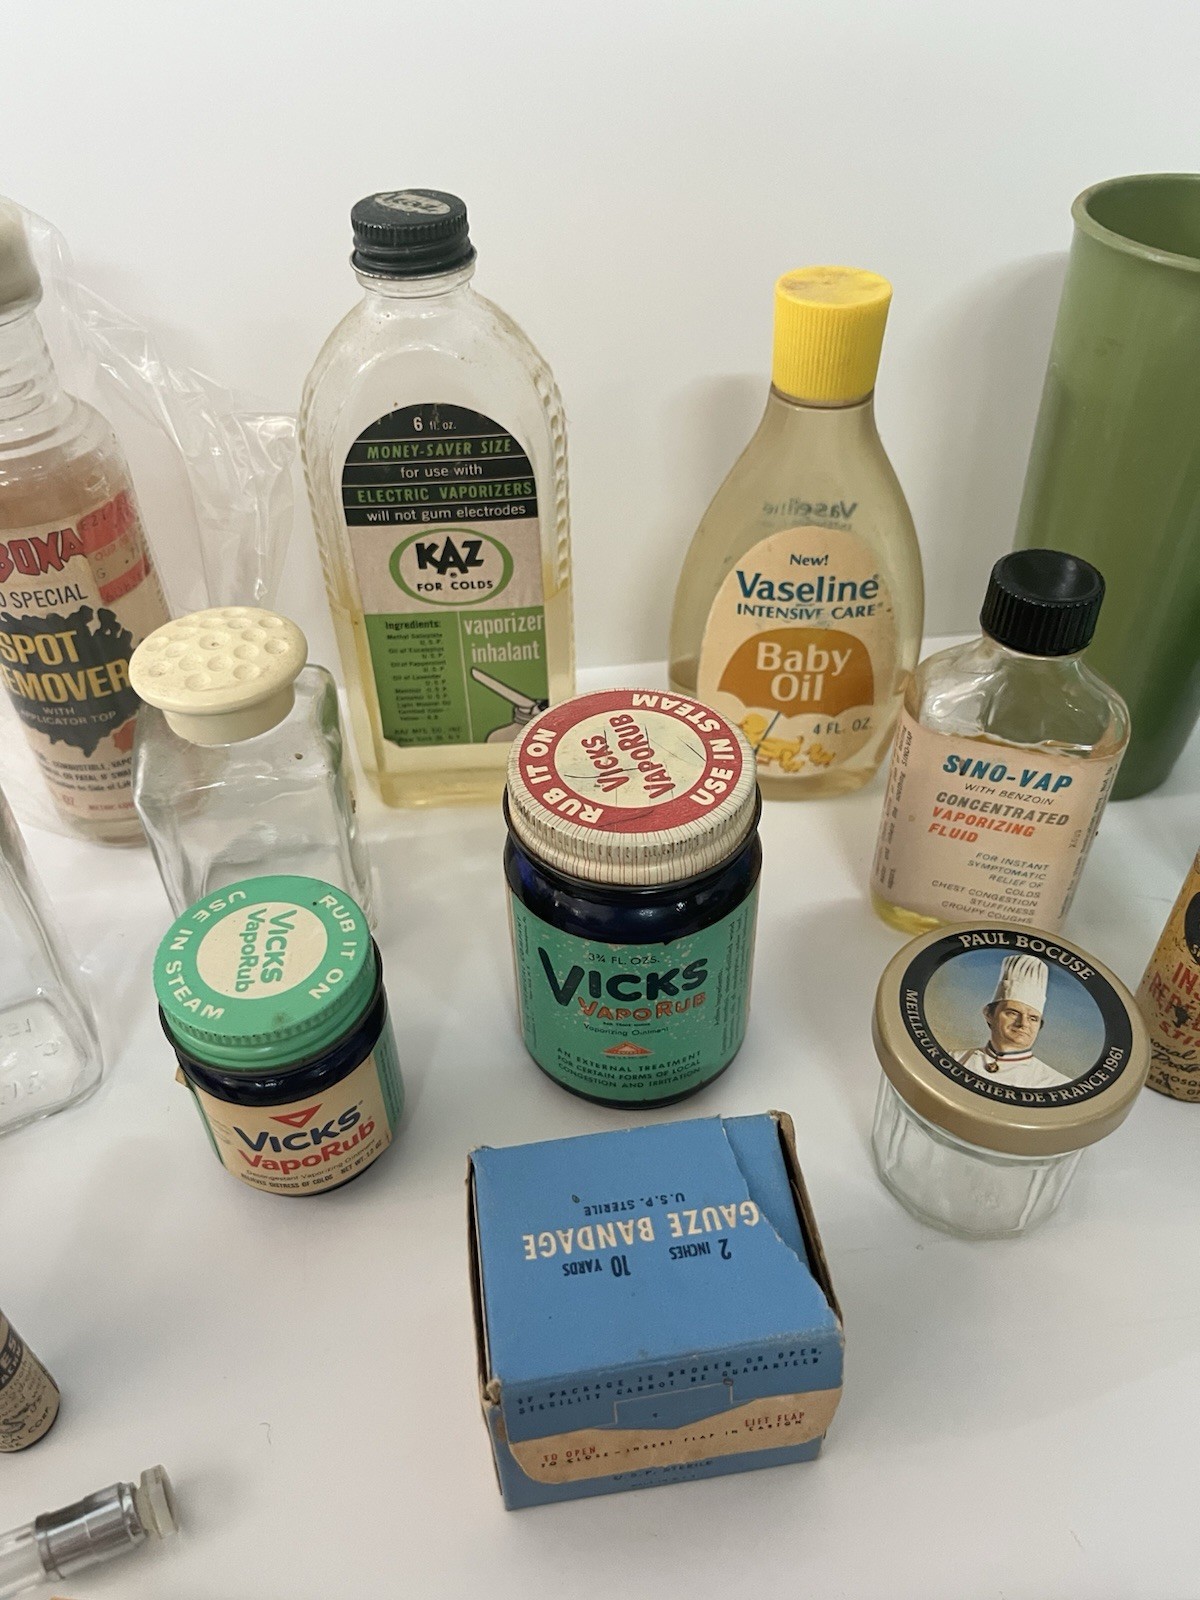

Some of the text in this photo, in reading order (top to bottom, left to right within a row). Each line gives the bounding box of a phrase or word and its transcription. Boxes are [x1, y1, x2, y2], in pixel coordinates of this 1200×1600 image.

[413, 416, 423, 431] 6
[442, 422, 457, 430] oz.
[367, 438, 512, 459] MONEY-SAVER SIZE
[400, 463, 483, 478] for use with
[357, 482, 532, 503] ELECTRIC VAPORIZERS
[367, 504, 526, 522] will not gum electrodes
[0, 527, 88, 583] BONA
[415, 536, 485, 575] KAZ
[790, 554, 829, 566] New!
[10, 583, 88, 609] SPECIAL
[417, 580, 494, 592] FOR COLDS
[736, 570, 879, 603] Vaseline
[831, 604, 876, 619] CARE
[386, 620, 442, 631] Ingredients:
[464, 612, 544, 639] vaporizer
[0, 629, 80, 667] SPOT
[472, 640, 540, 664] inhalant
[756, 641, 852, 677] Baby
[1, 657, 131, 705] EMOVER
[770, 673, 824, 702] Oil
[42, 706, 76, 716] WITH
[90, 710, 118, 723] TOP
[812, 722, 822, 735] 4
[609, 714, 676, 799] VAPORUB
[631, 693, 735, 806] USE IN STEAM
[901, 730, 914, 767] SINO-VAP
[526, 728, 604, 824] RUB IT ON
[581, 735, 630, 793] VICKS
[942, 754, 1073, 794] SINO-VAP
[964, 782, 1055, 806] WITH BENZOIN
[932, 806, 1036, 838] VAPORIZING
[936, 791, 1070, 826] CONCENTRATED
[928, 822, 979, 843] FLUID
[967, 859, 1047, 880] SYMPTOMATIC
[976, 852, 1050, 871] FOR INSTANT
[931, 880, 1038, 907] CHEST CONGESTION
[988, 874, 1027, 888] RELIEF
[1005, 887, 1041, 898] COLDS
[941, 900, 1034, 924] CROUPY COUGHS
[969, 898, 1036, 916] STUFFINESS
[166, 890, 247, 1020] USE IN STEAM
[234, 908, 268, 993] VapoRub
[260, 909, 298, 984] VICKS
[308, 894, 358, 1000] RUB IT ON
[958, 932, 1096, 981] PAUL BOCUSE
[611, 956, 627, 965] FL.
[630, 956, 661, 966] OZS.
[538, 946, 708, 1007] VICKS
[578, 992, 706, 1022] VAPORUB
[583, 1023, 628, 1037] Vaporizing
[631, 1026, 669, 1036] Ointment
[905, 988, 941, 1058] MEILLEUR
[938, 1056, 1017, 1101] OUVRIER
[1020, 1091, 1046, 1104] DE
[1048, 1070, 1112, 1102] FRANCE
[1102, 1046, 1124, 1073] 1961
[556, 1048, 701, 1072] AN EXTERNAL TREATMENT
[557, 1054, 701, 1081] FOR CERTAIN FORMS OF LOCAL
[558, 1063, 617, 1088] CONGESTION
[622, 1081, 645, 1089] AND
[1158, 1068, 1200, 1088] MOSQ
[232, 1105, 363, 1153] VICKS
[237, 1118, 376, 1176] VapoRub
[300, 1162, 344, 1179] Vaporizing
[584, 1192, 686, 1217] U.S.P. STERILE
[522, 1200, 760, 1261] GAUZE BANDAGE
[562, 1238, 732, 1278] 2 INCHES 10 YARDS
[518, 1356, 820, 1415] STERILITY CANNOT BE GUARANTEED
[549, 1380, 624, 1399] PACKAGE
[668, 1360, 732, 1378] BROKEN
[744, 1411, 806, 1428] LIFT FLAP
[543, 1446, 597, 1462] TO OPEN
